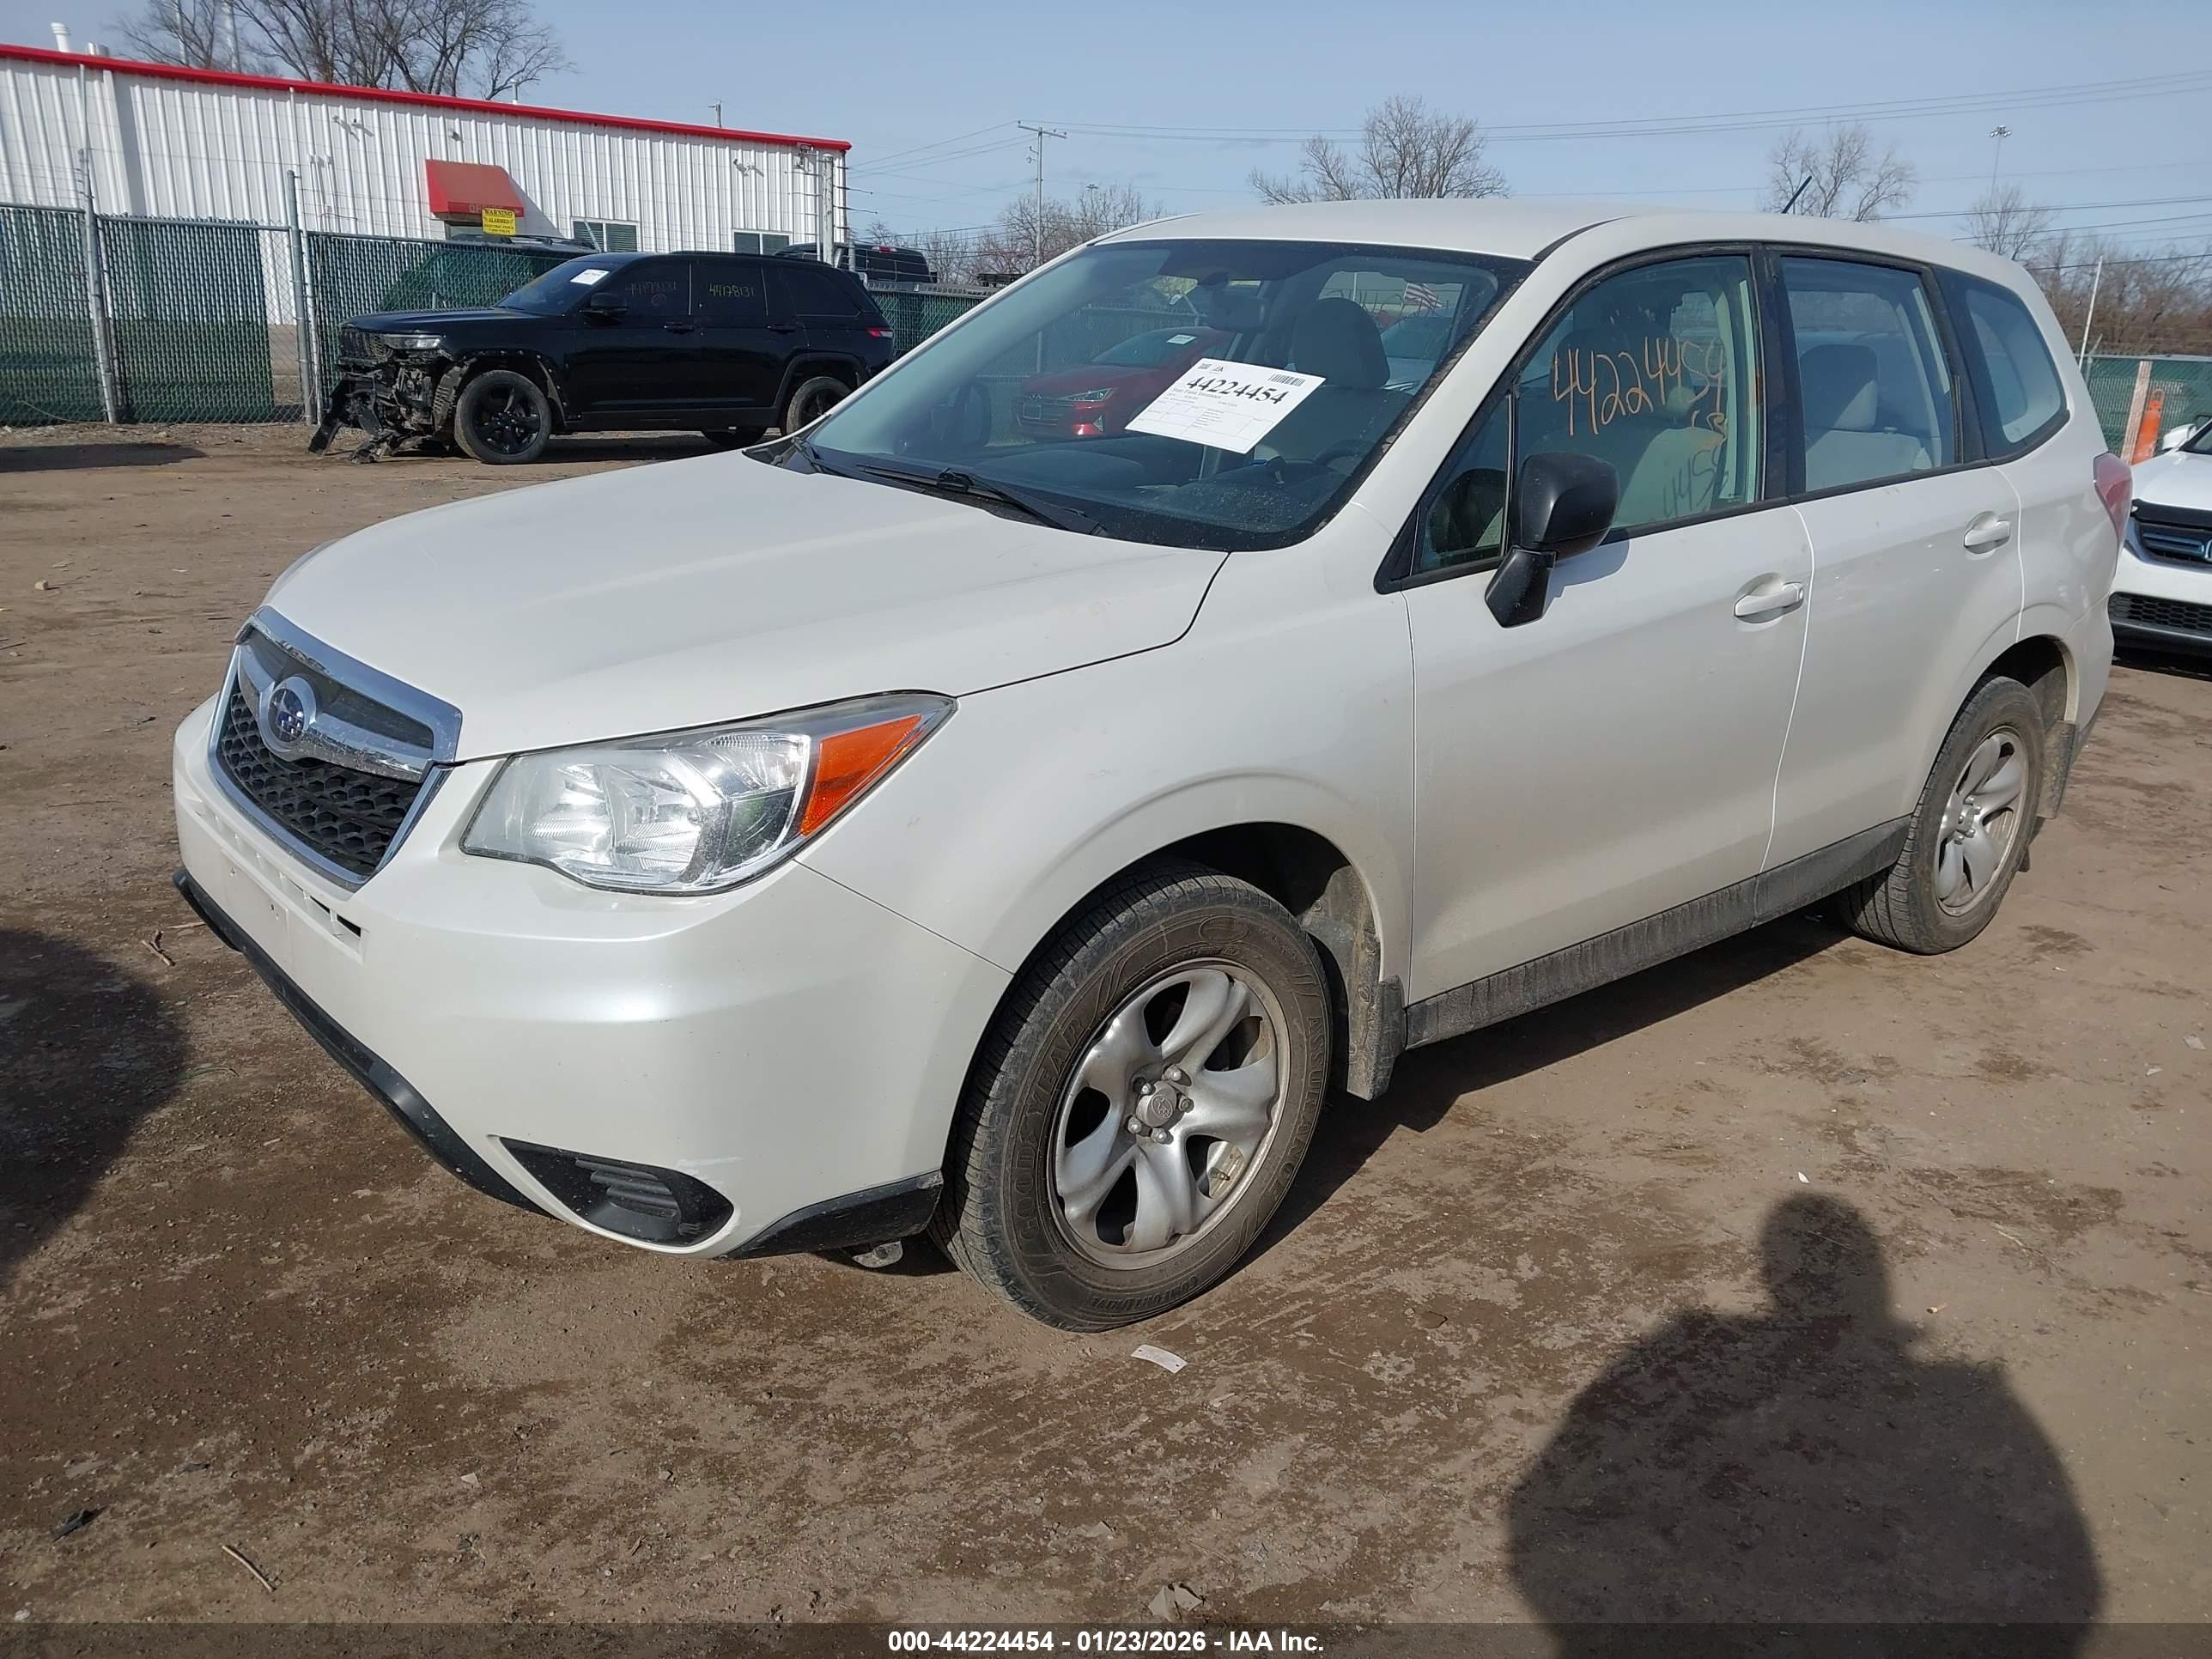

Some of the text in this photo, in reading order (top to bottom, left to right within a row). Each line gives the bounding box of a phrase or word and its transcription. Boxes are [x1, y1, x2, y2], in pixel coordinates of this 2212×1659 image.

[1187, 376, 1290, 405] 44224454
[1013, 1017, 1085, 1243] GOODYEAR
[1268, 1017, 1326, 1200] ASSURANCE
